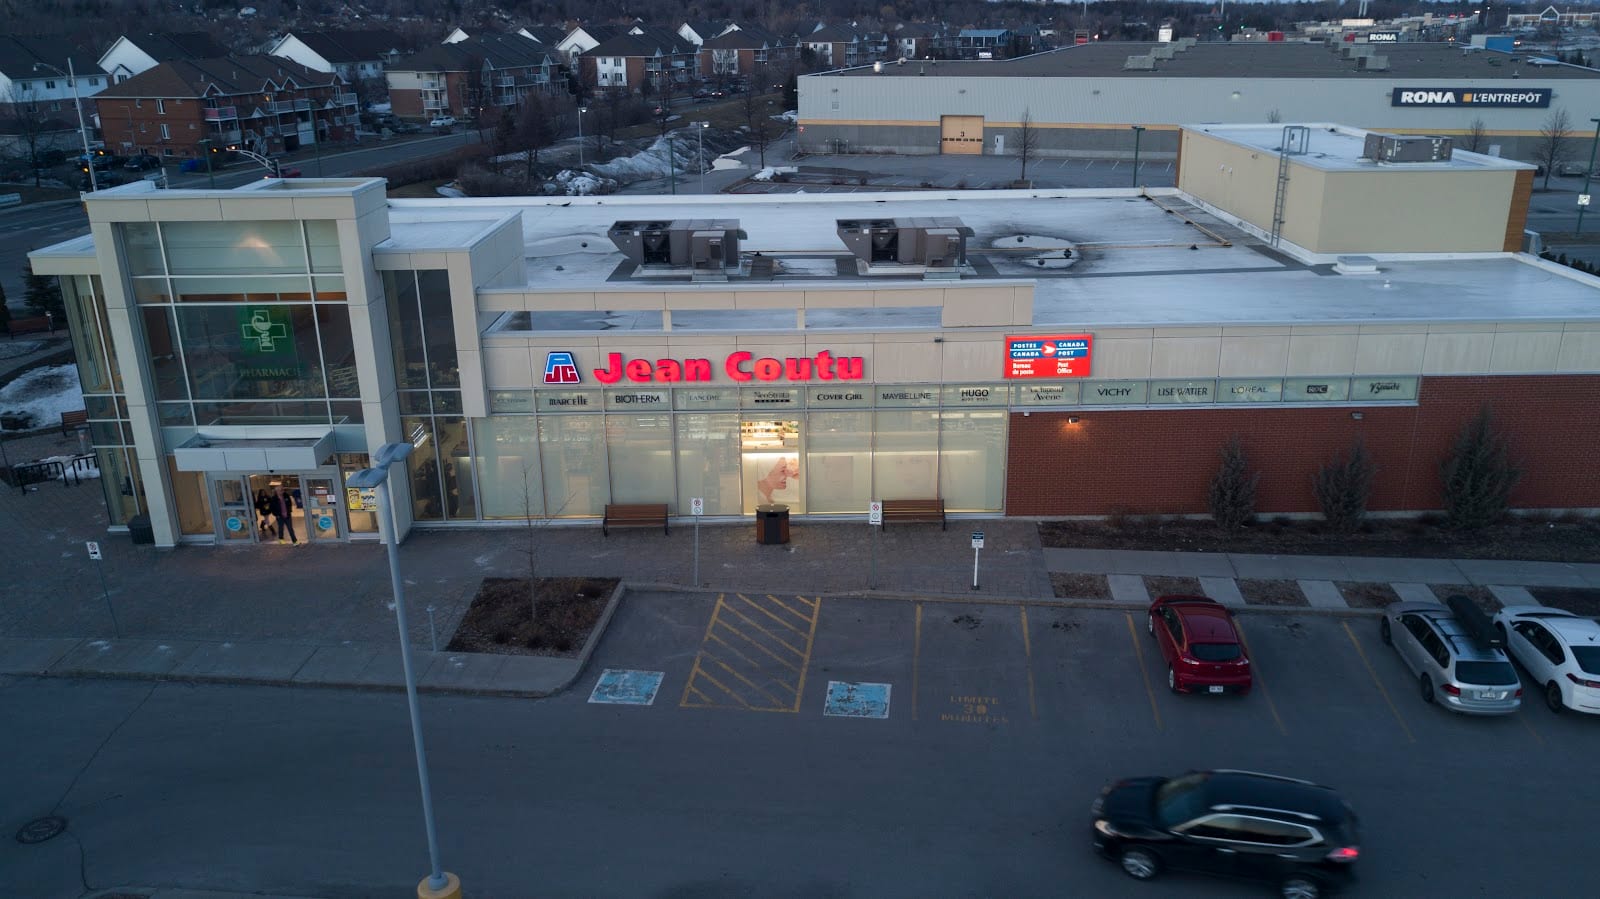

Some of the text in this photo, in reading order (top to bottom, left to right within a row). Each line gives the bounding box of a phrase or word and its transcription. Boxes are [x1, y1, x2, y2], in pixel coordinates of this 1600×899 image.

[1369, 33, 1397, 42] RONA
[1401, 90, 1542, 104] RONA L'ENTREPÔT
[593, 350, 863, 384] Jean Coutu
[961, 389, 989, 397] HUGO
[1097, 388, 1131, 397] VICHY
[1158, 387, 1174, 396] LISE
[615, 394, 660, 404] BIOTHERM
